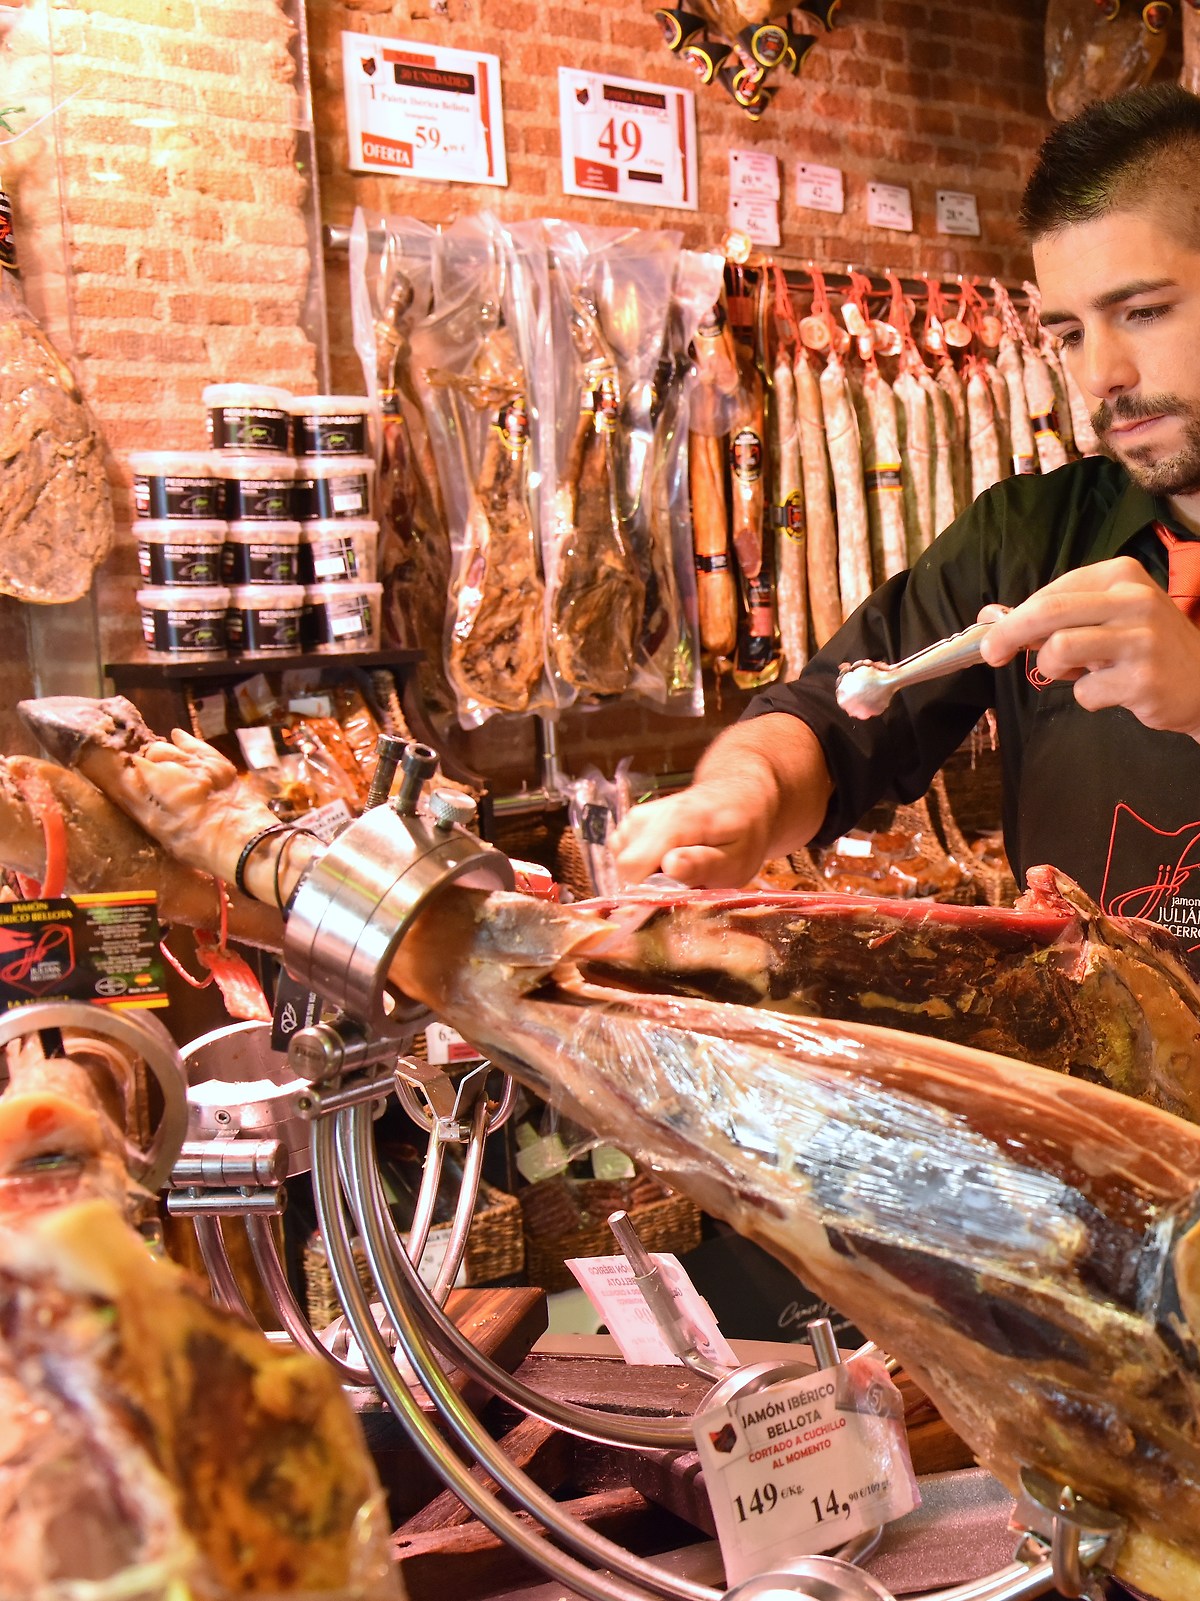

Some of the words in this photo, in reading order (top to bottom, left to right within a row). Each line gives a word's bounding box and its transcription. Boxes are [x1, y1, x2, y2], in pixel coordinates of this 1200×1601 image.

[412, 70, 469, 88] UNIDADES
[363, 141, 411, 165] OFERTA
[598, 117, 642, 163] 49
[31, 909, 73, 922] BELLOTA
[741, 1401, 786, 1429] JAMÓN
[789, 1383, 836, 1411] IBÉRICO
[767, 1409, 823, 1440] BELLOTA
[748, 1438, 794, 1463] CORTADO
[795, 1436, 803, 1446] A
[803, 1418, 847, 1442] CUCHILLO
[772, 1459, 784, 1470] AL
[786, 1439, 832, 1465] MOMENTO
[733, 1482, 778, 1523] 149
